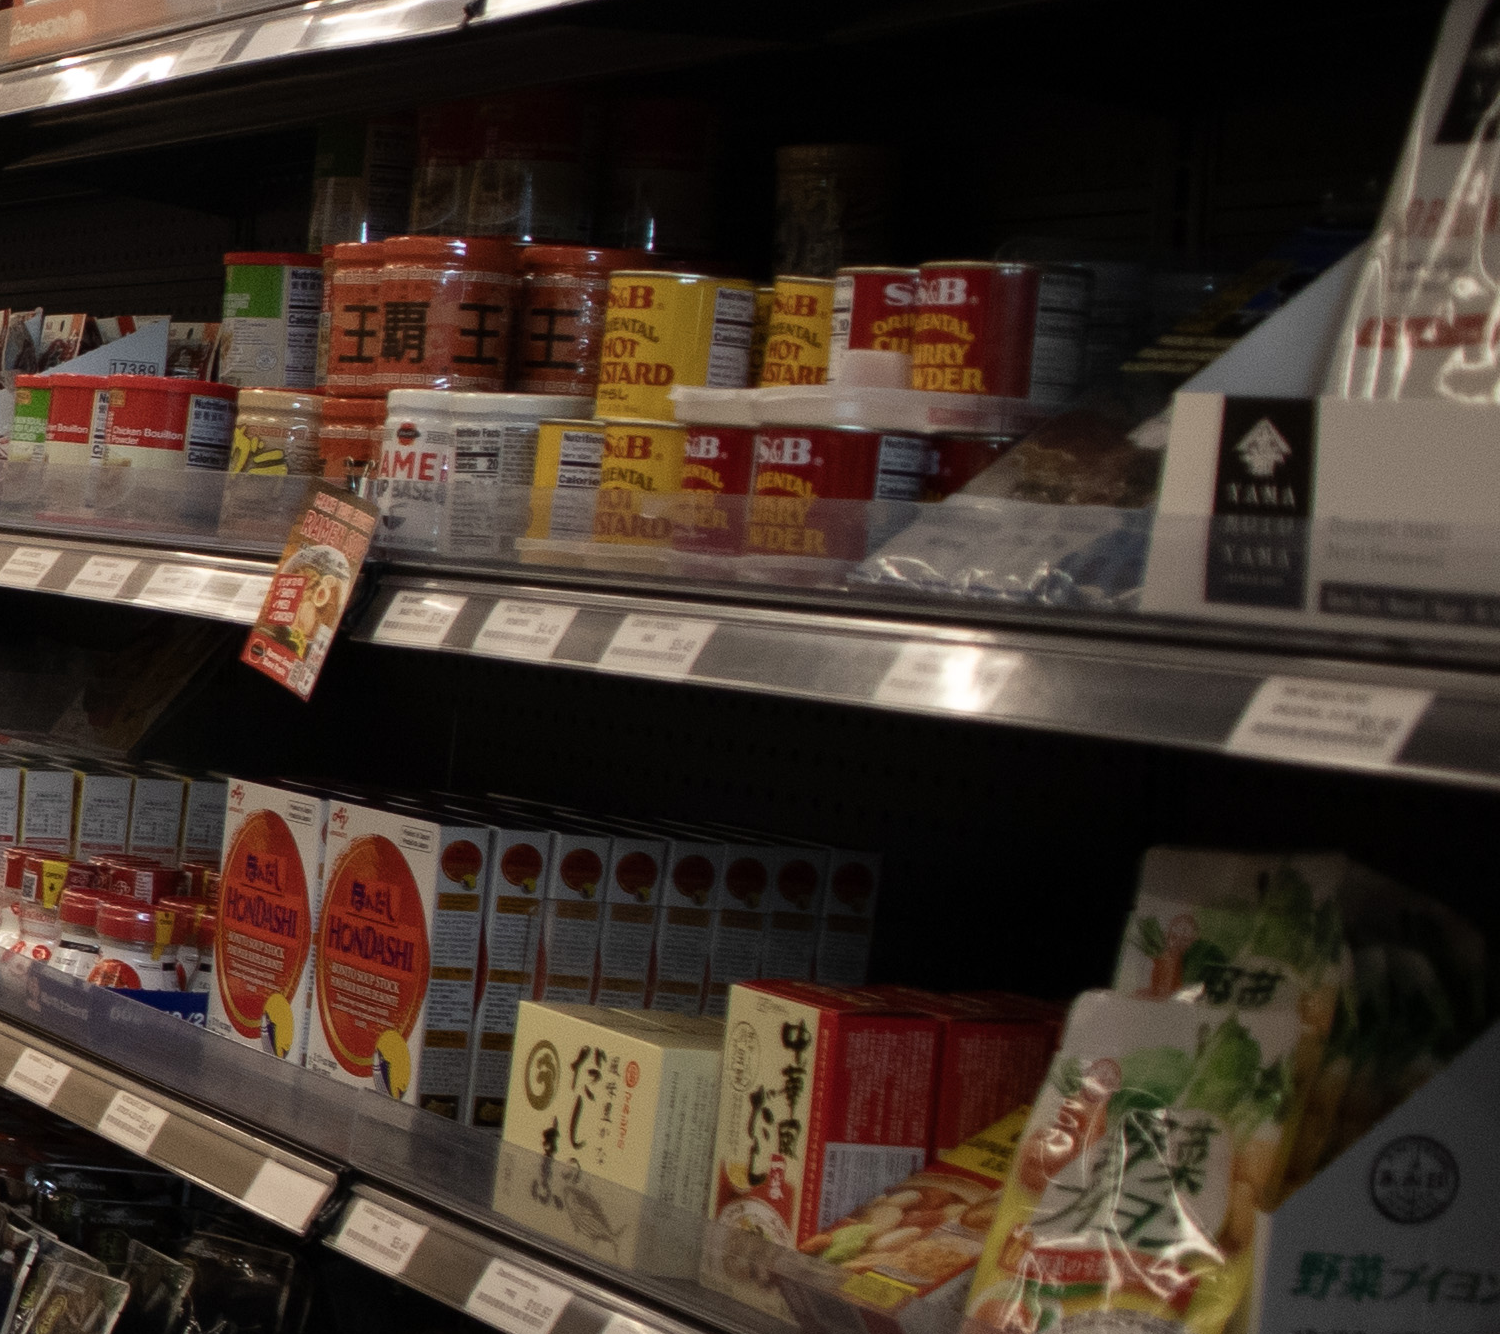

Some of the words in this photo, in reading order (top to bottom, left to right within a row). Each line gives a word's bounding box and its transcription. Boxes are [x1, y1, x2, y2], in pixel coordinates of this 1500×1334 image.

[604, 336, 640, 358] HOT
[601, 362, 675, 386] STARD
[112, 425, 142, 436] Chicken
[144, 428, 185, 441] Bouillon
[112, 435, 140, 446] Powder
[755, 436, 813, 466] S&B
[1224, 481, 1298, 509] YAMA
[1220, 544, 1291, 568] YAMA
[224, 886, 300, 939] HONDASHI
[326, 919, 415, 973] HONDASHI
